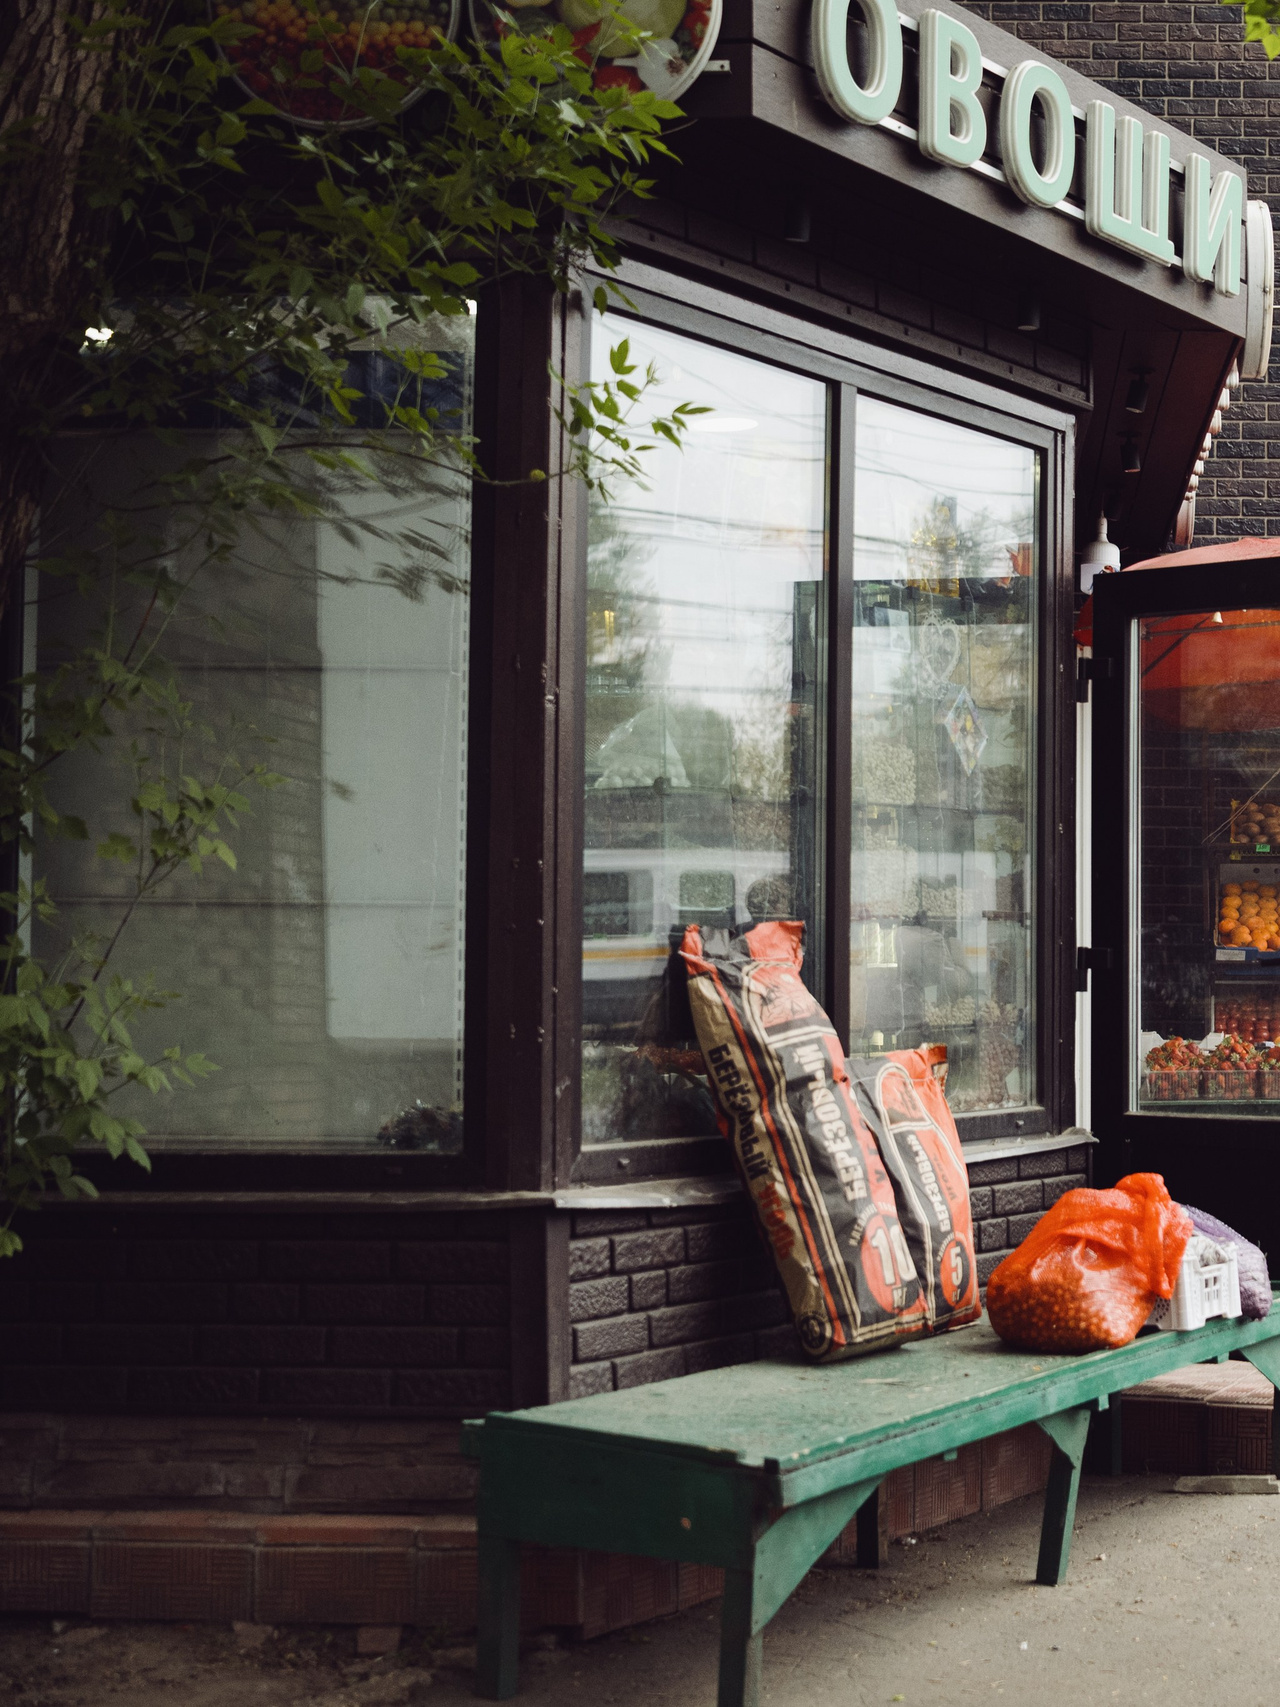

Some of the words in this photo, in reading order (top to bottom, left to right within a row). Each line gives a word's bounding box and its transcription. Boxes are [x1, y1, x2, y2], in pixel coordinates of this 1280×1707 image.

[810, 0, 1243, 298] ОВОЩИ
[871, 1224, 918, 1286] 10
[950, 1246, 963, 1287] 5
